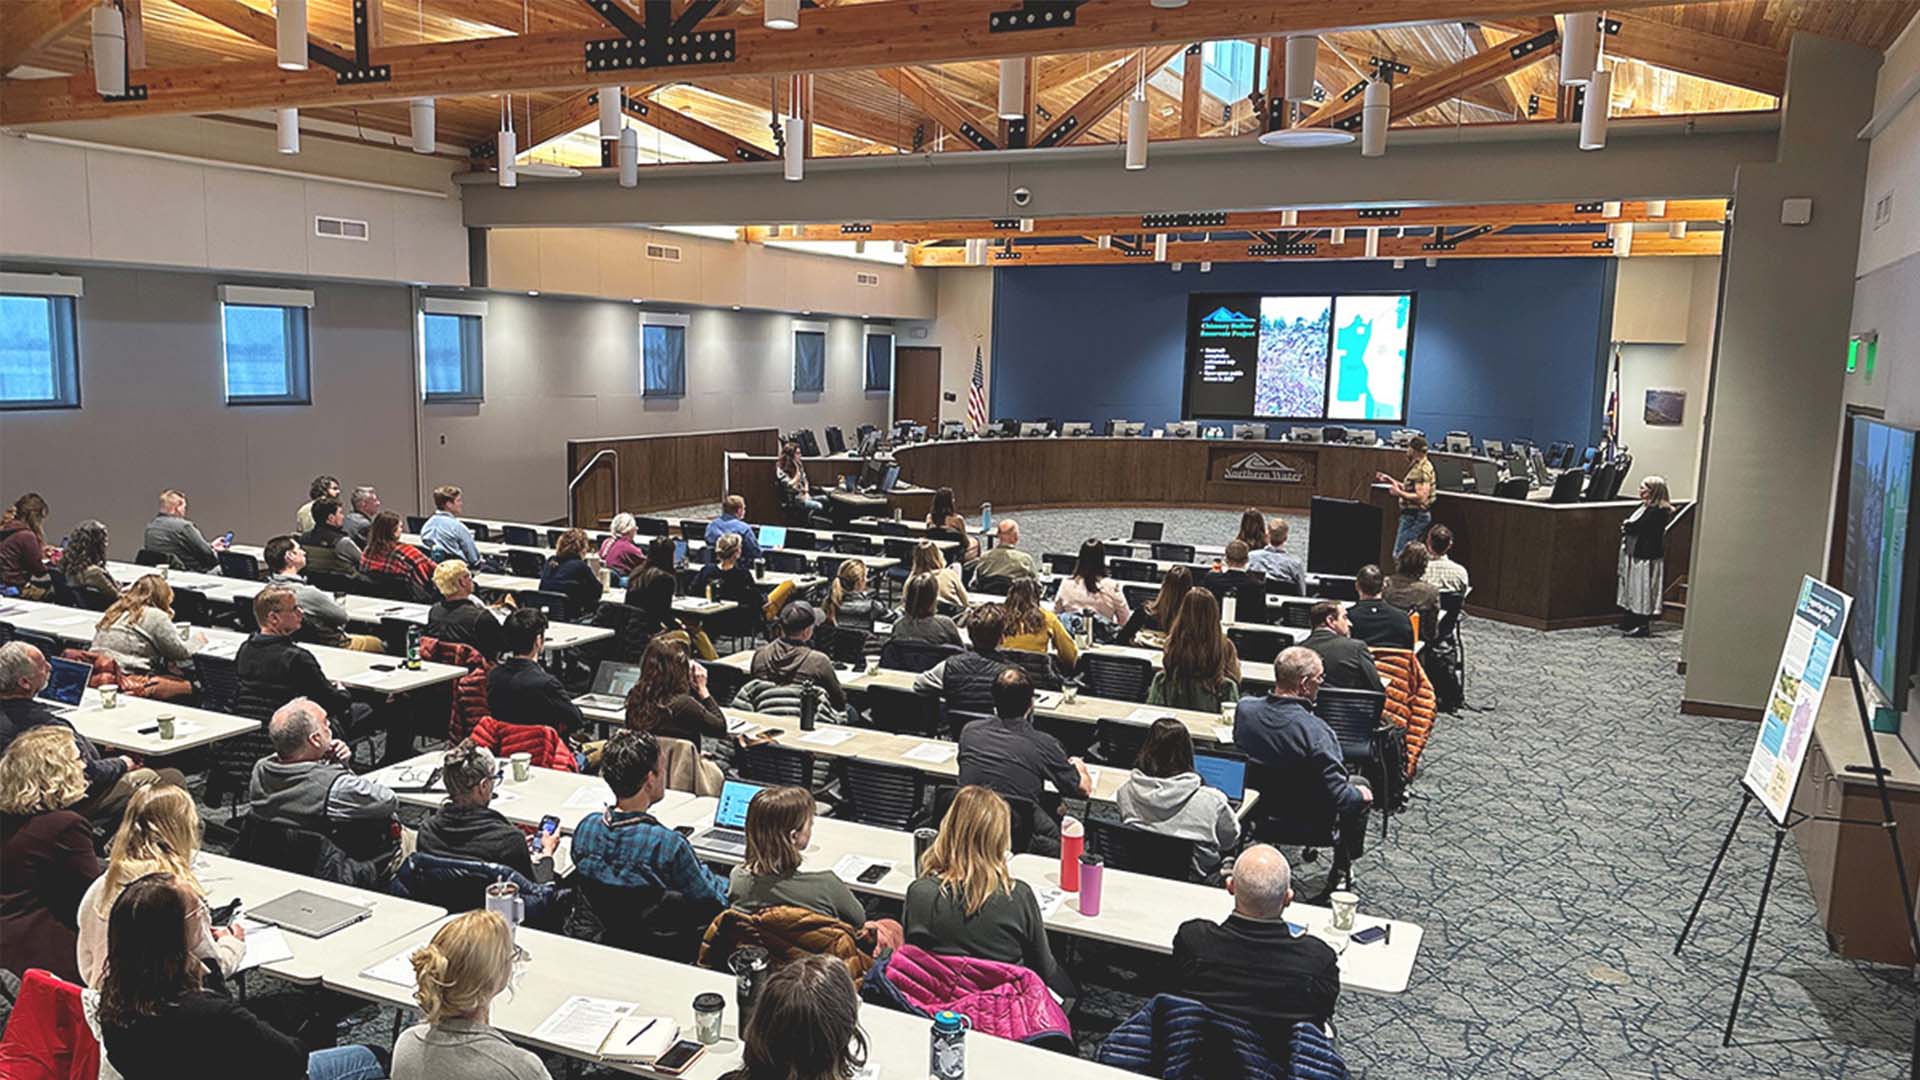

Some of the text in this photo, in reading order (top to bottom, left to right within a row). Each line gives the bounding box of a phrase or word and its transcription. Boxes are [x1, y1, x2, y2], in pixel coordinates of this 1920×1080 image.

[1232, 330, 1256, 338] Project
[1224, 468, 1303, 482] Northern Water
